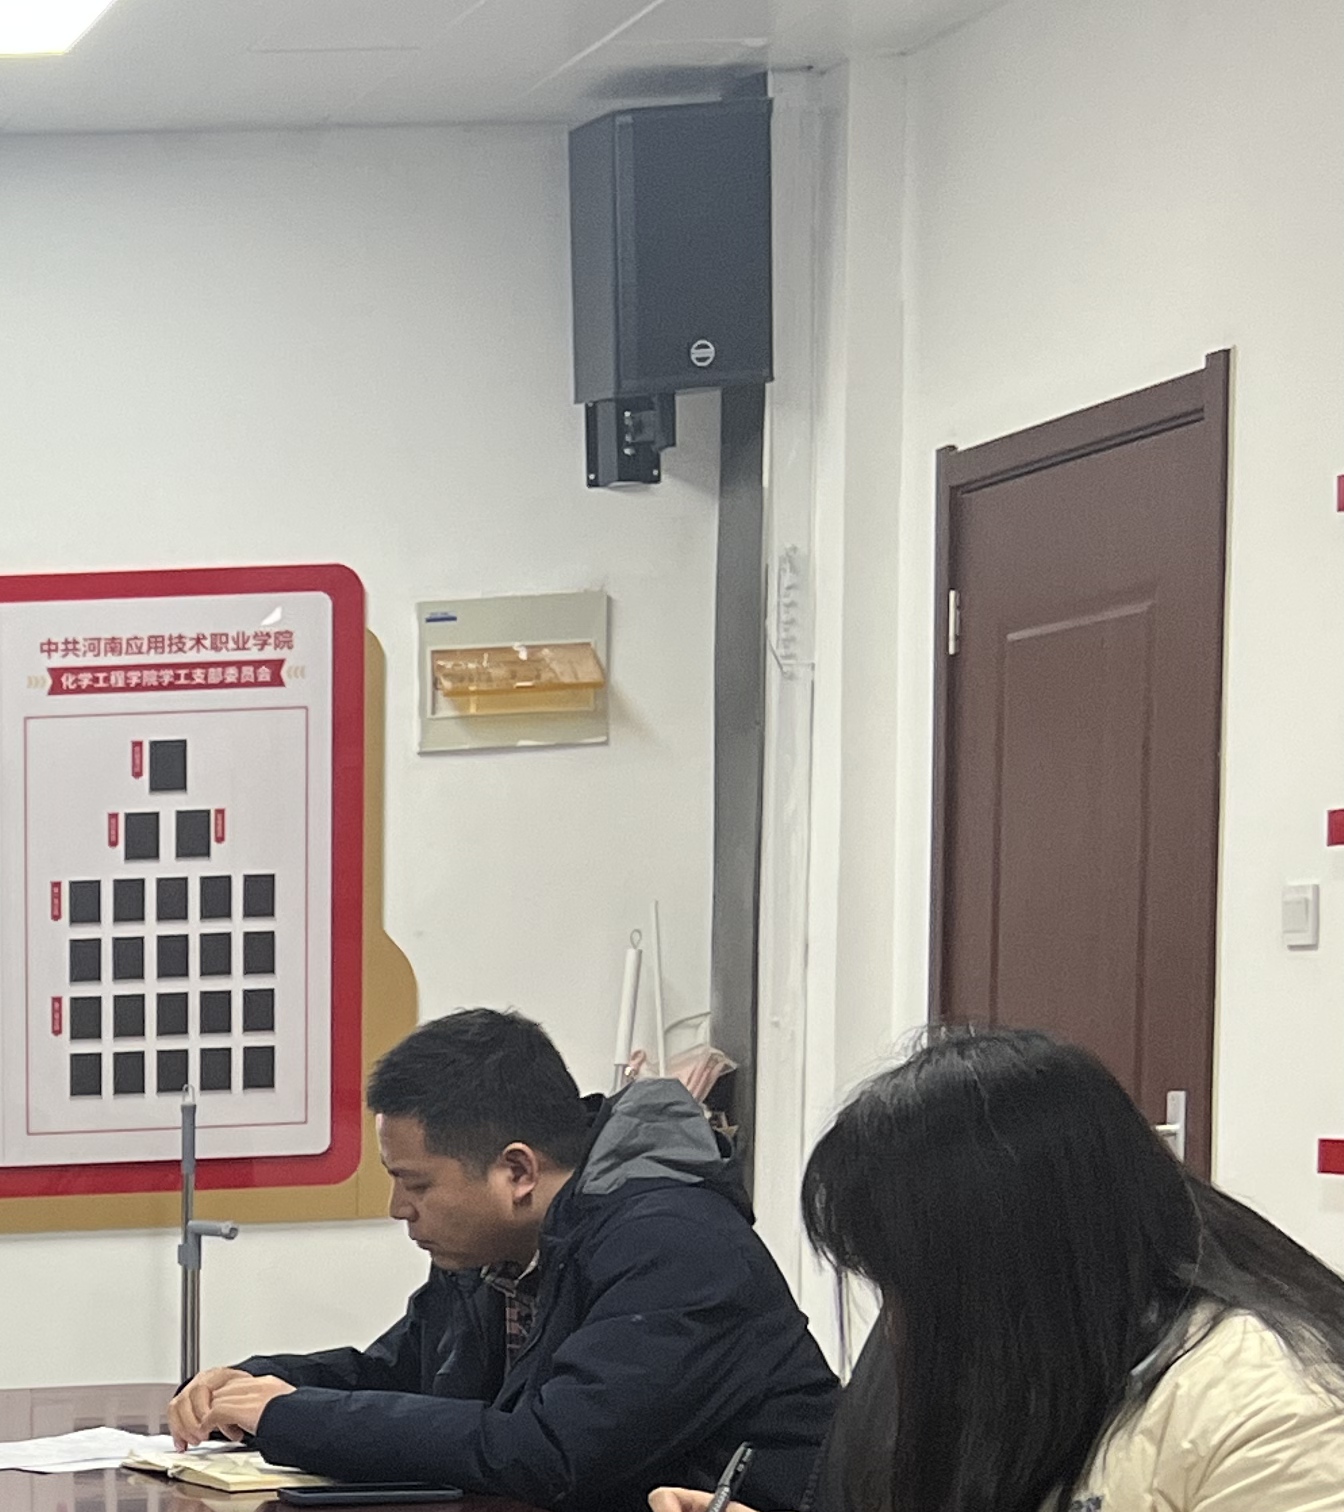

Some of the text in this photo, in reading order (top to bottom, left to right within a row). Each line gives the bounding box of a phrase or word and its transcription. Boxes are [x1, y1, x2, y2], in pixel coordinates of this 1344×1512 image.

[39, 629, 295, 659] 中共河南应用技术职业学院
[60, 665, 273, 691] 化学工程学院学工支部委员会
